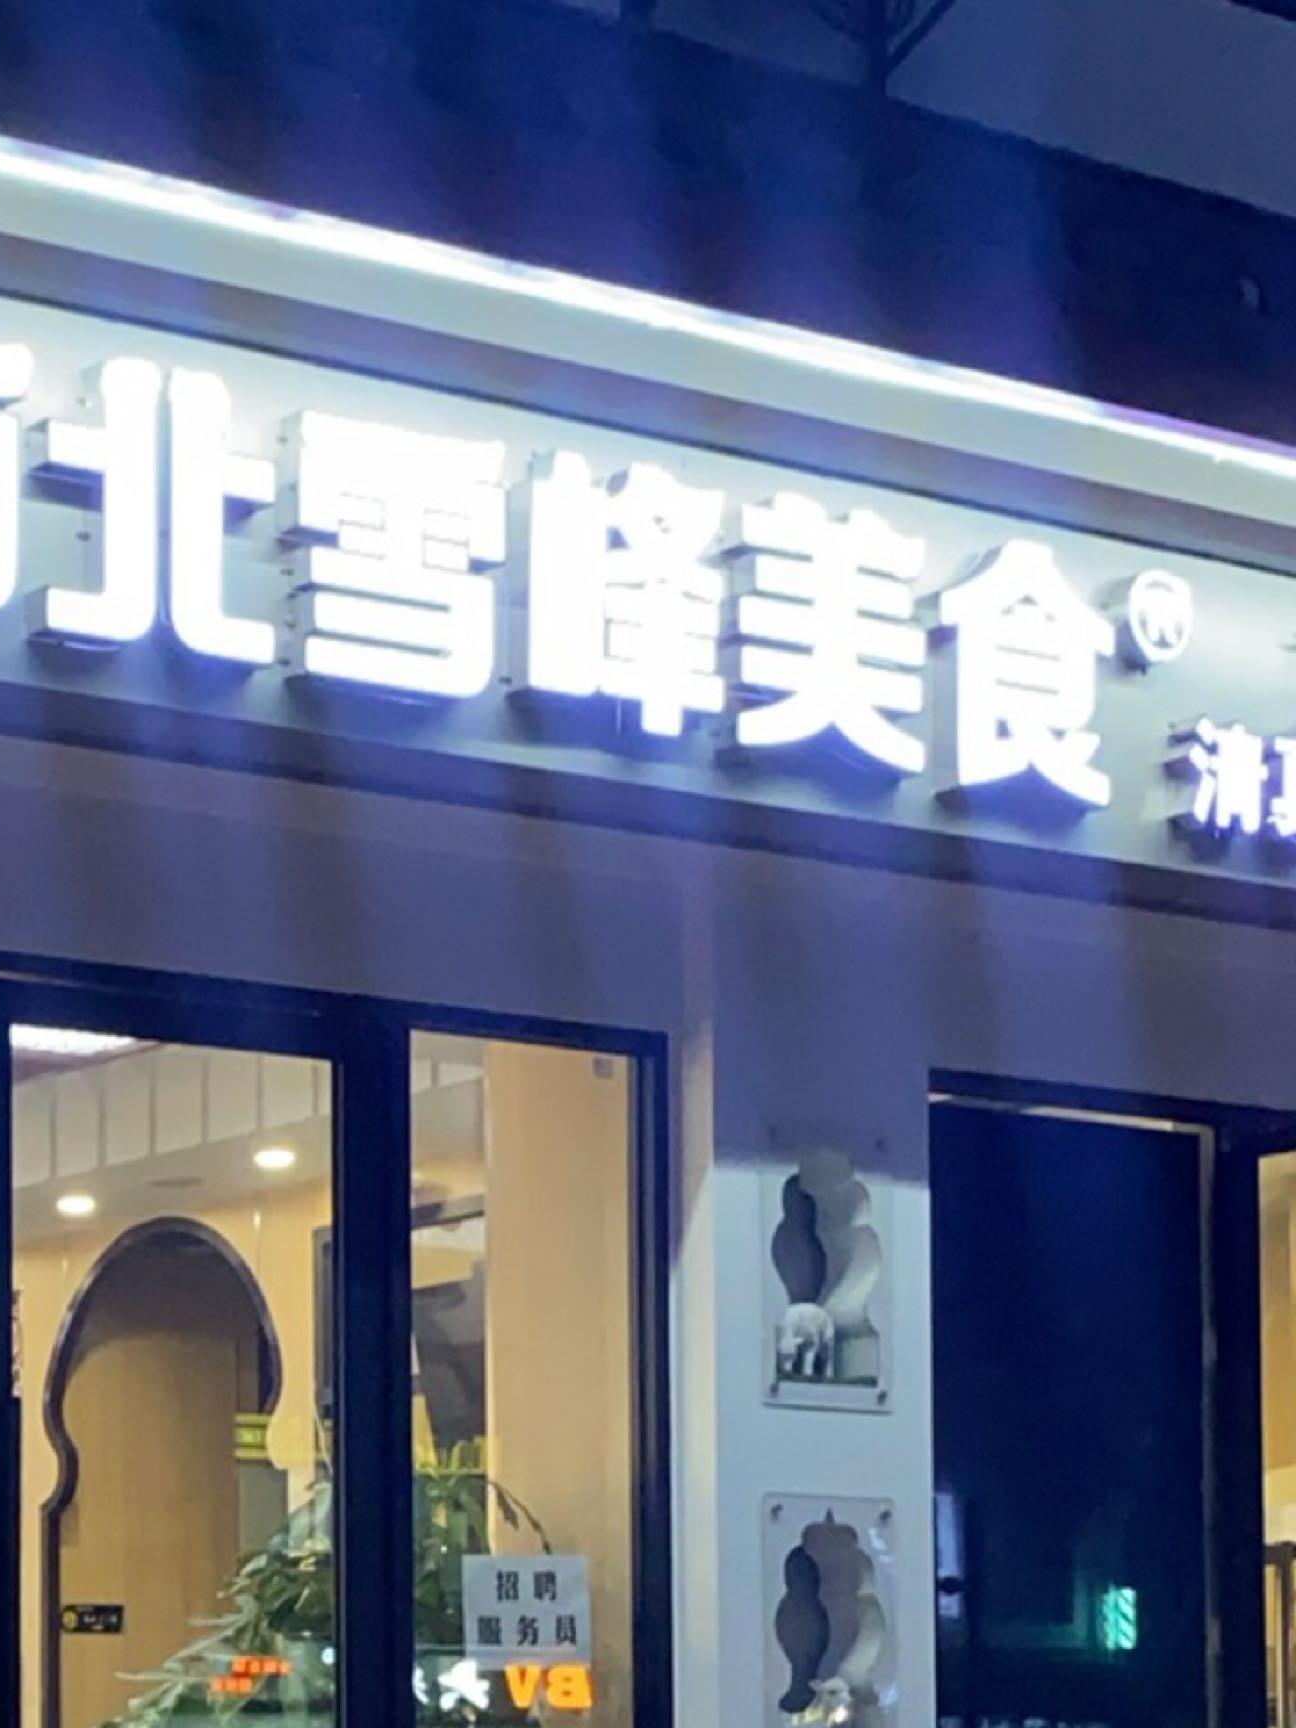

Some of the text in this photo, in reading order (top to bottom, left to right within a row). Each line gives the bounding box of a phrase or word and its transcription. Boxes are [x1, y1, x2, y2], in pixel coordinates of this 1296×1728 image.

[496, 1568, 556, 1602] 招聘
[477, 1614, 576, 1647] 服务员
